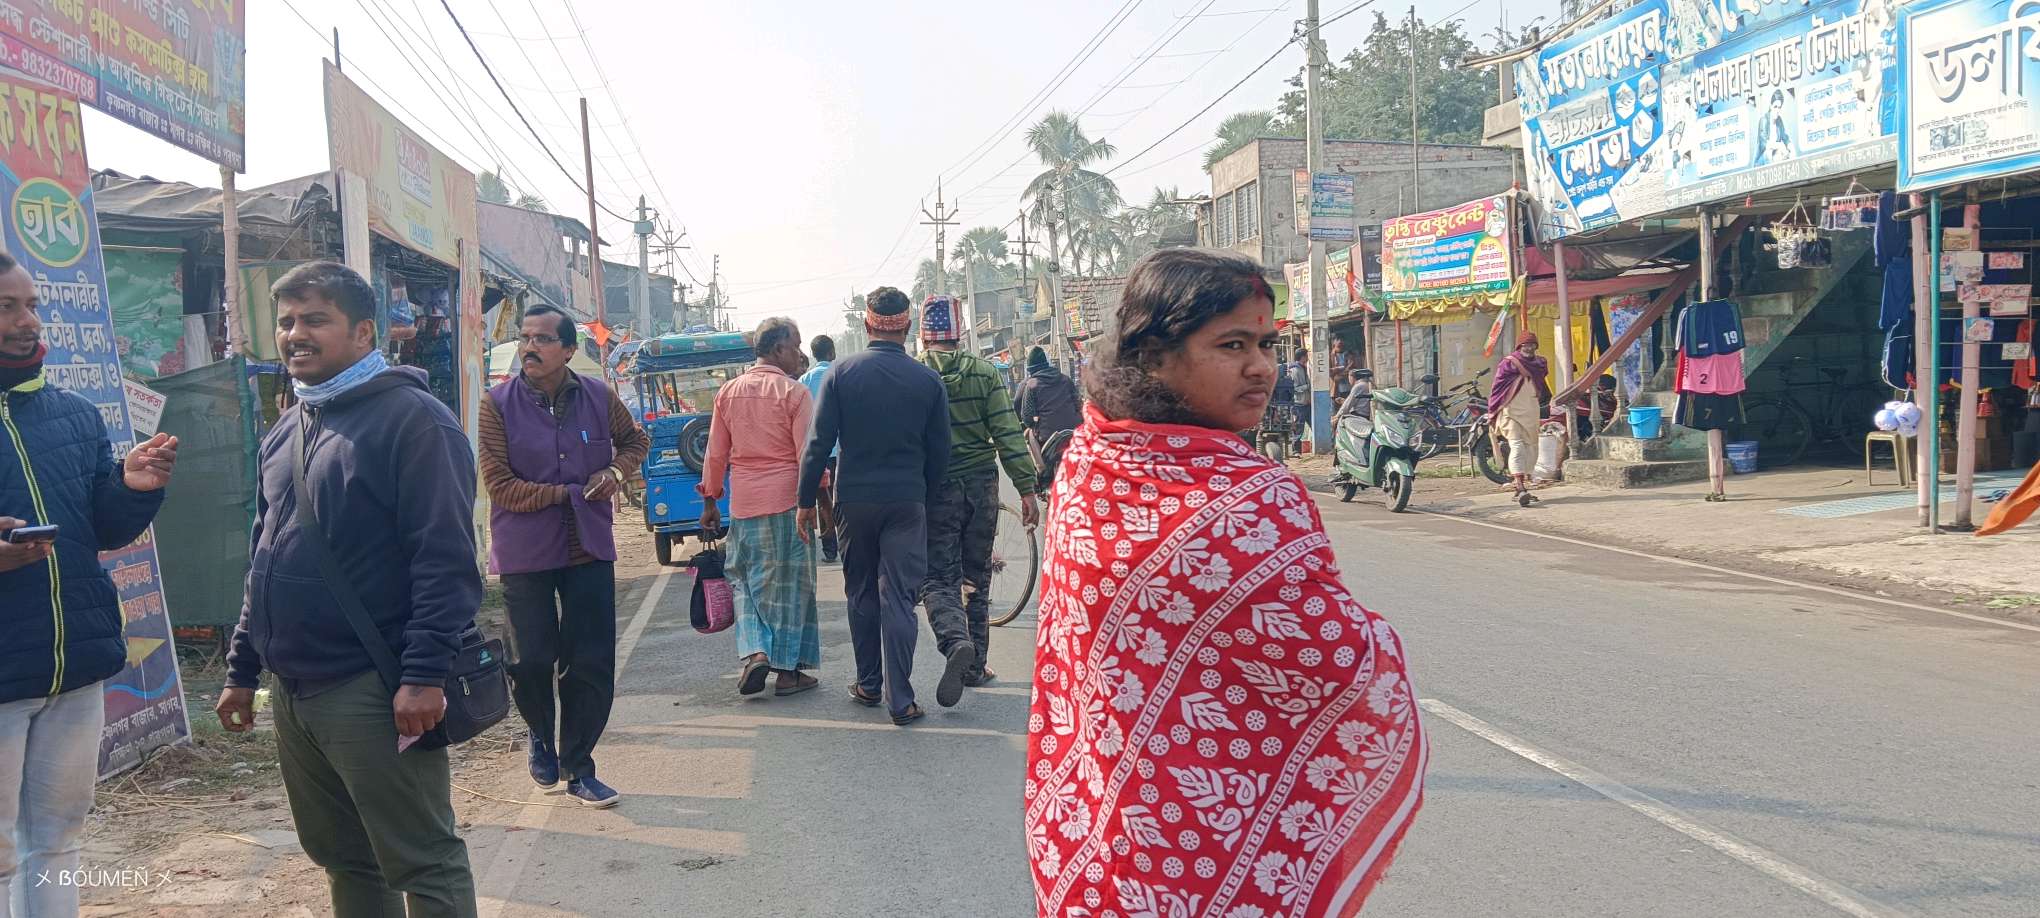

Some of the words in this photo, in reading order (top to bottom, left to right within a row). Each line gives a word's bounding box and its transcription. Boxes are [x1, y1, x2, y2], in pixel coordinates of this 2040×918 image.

[21, 48, 95, 100] 9832370768
[19, 195, 81, 250] হাব
[1723, 330, 1738, 345] 19
[1700, 373, 1708, 384] 2
